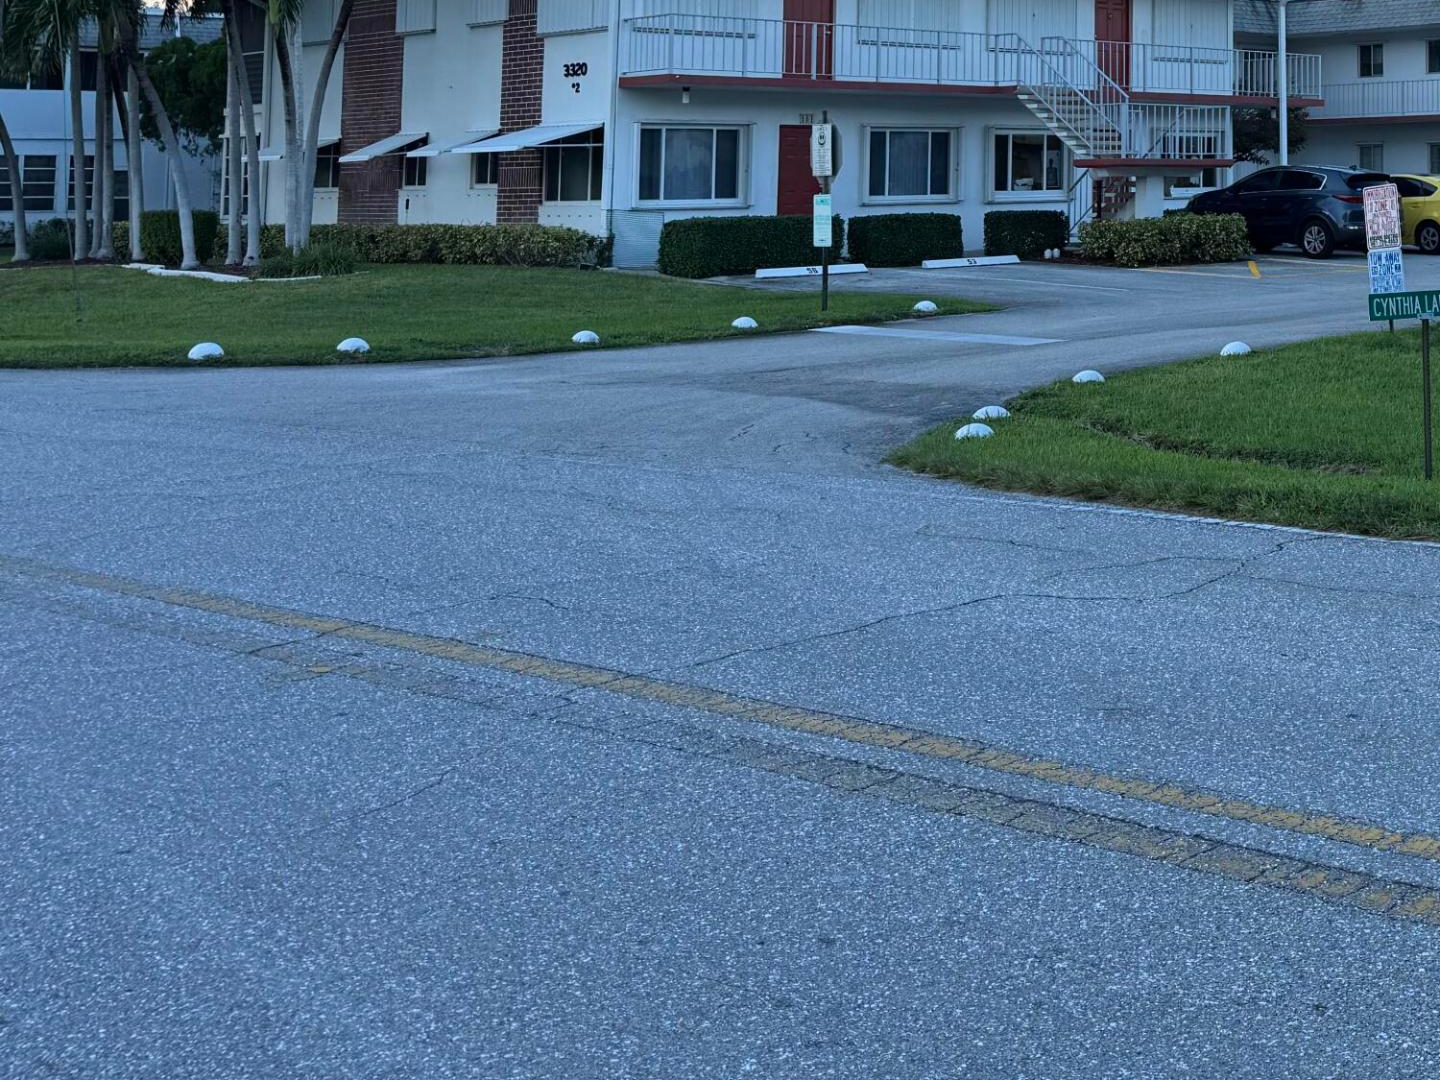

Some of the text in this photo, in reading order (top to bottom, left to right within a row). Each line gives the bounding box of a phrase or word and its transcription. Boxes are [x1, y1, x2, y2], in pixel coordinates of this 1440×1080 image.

[563, 62, 588, 77] 3320
[1370, 251, 1400, 265] TOW AWAY
[1379, 263, 1394, 275] ZONE
[1373, 296, 1422, 317] CYNTHIA
